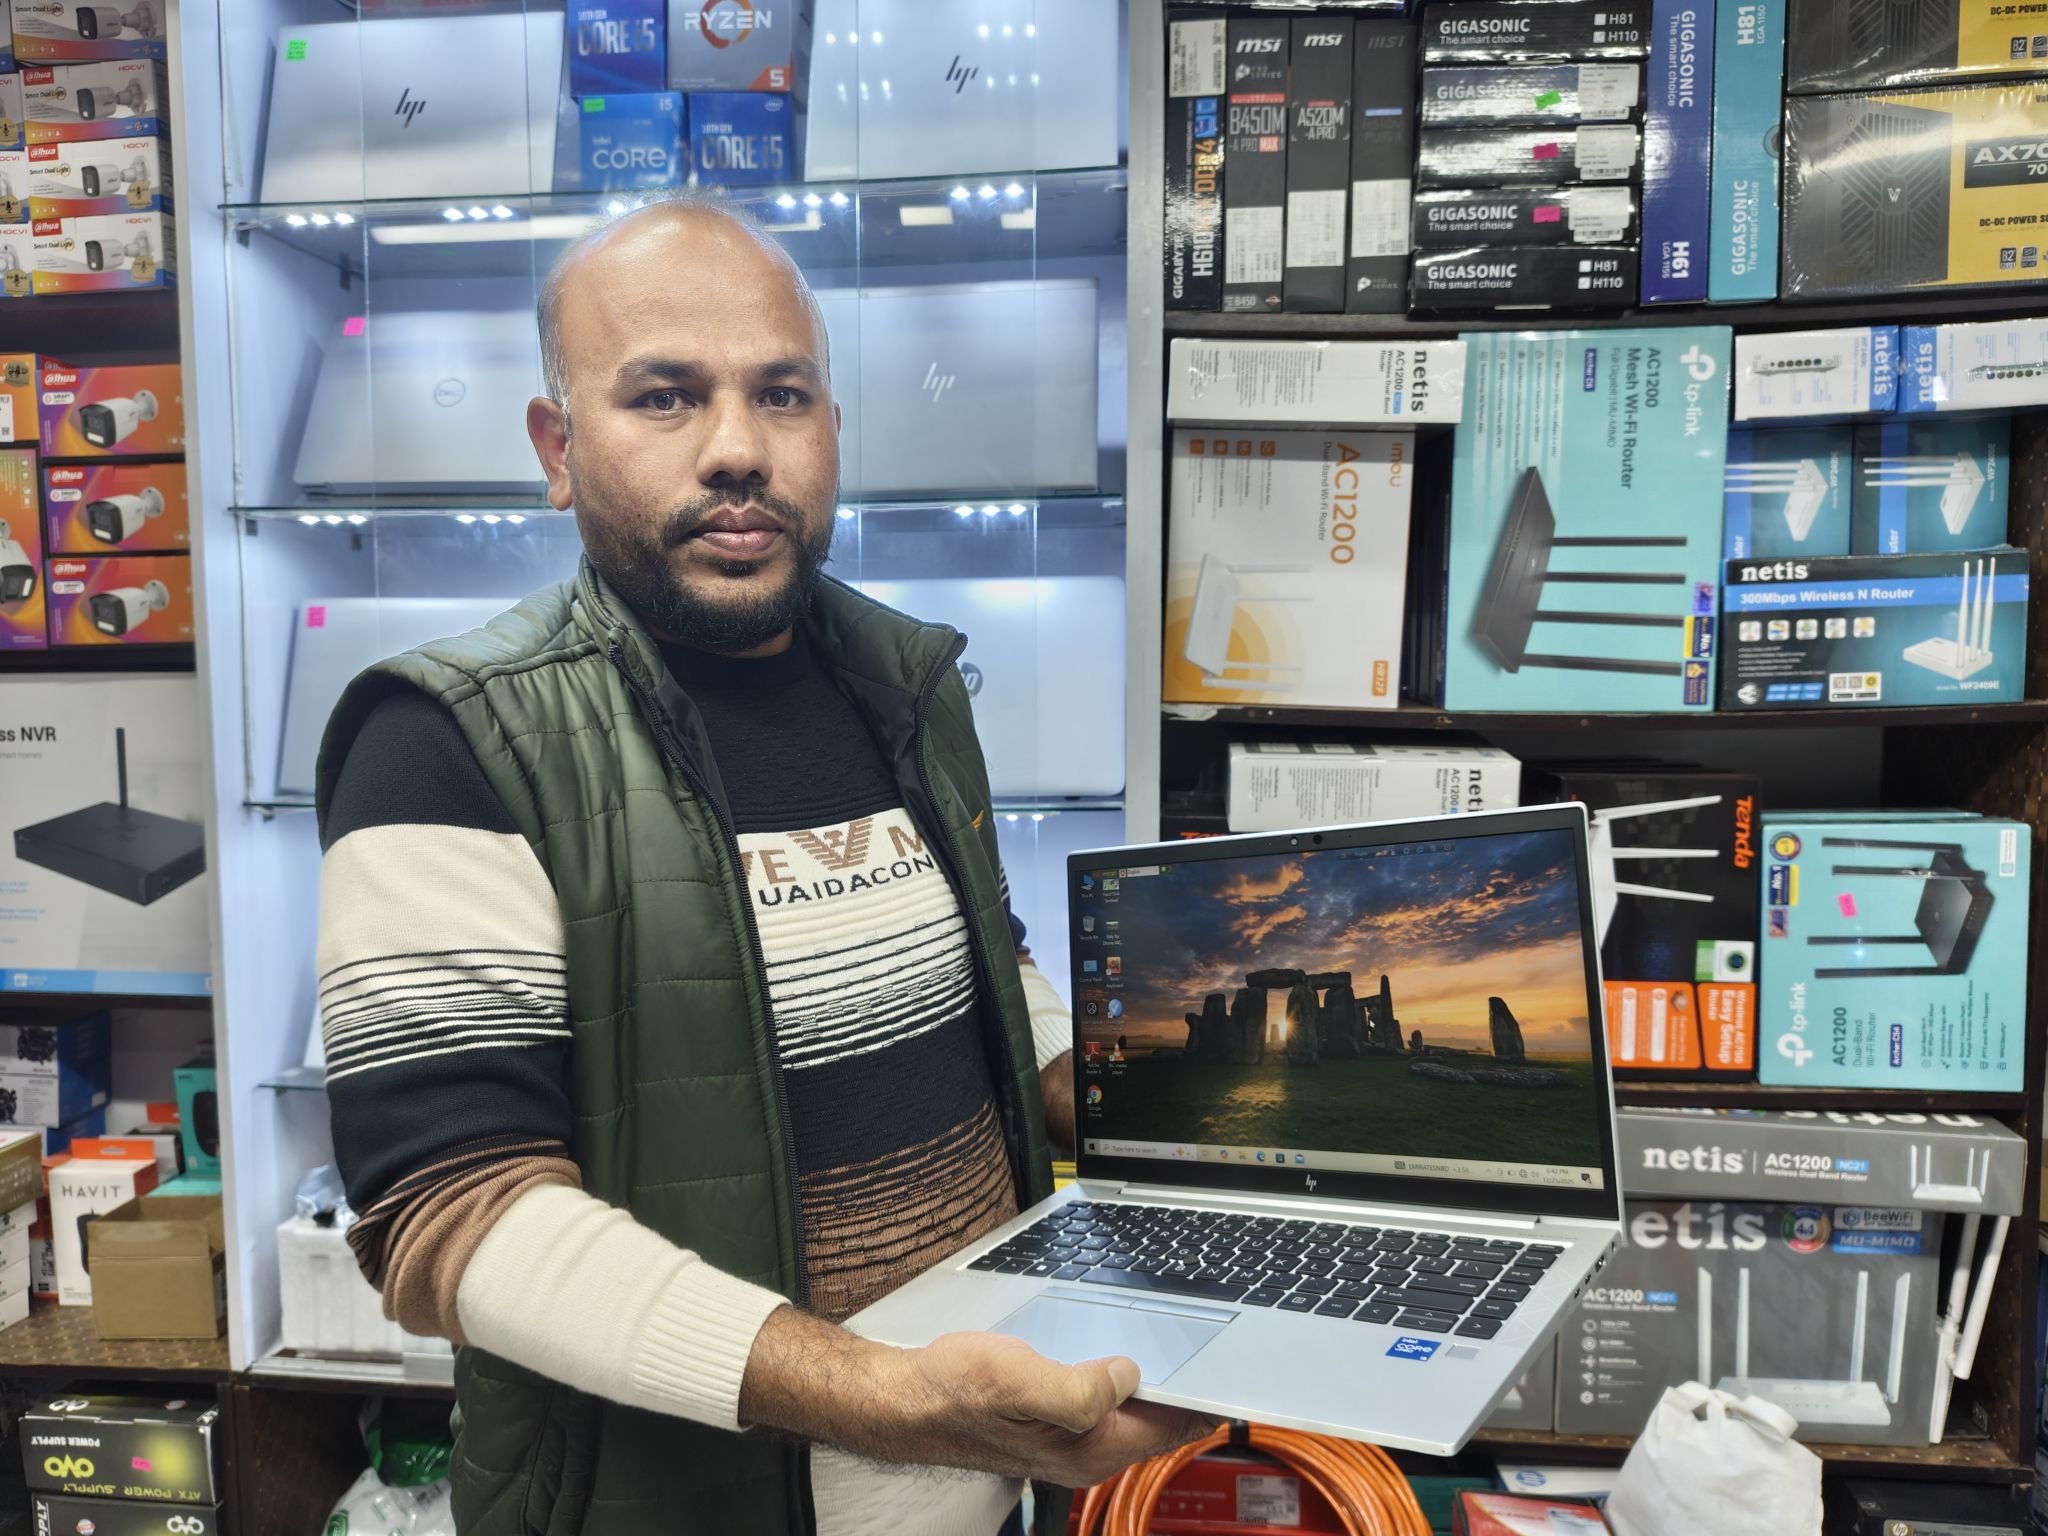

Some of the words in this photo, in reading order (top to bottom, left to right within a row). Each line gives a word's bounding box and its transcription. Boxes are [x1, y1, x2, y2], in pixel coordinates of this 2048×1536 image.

[33, 4, 47, 12] Dual
[1990, 6, 2016, 16] DC-DC
[2018, 3, 2048, 14] POWER
[684, 10, 772, 31] RYZEN
[1439, 19, 1531, 34] GIGASONIC
[1609, 14, 1633, 25] H81
[1669, 14, 1680, 35] The
[1737, 5, 1755, 45] H81
[577, 20, 630, 56] CORE
[634, 18, 655, 50] i5
[1235, 37, 1282, 53] msi
[1304, 34, 1344, 47] msi
[1368, 35, 1405, 49] msi
[1440, 36, 1458, 44] The
[1461, 36, 1493, 44] smart
[1495, 34, 1526, 44] choice
[1608, 31, 1639, 42] H110
[2013, 39, 2025, 51] 82
[1669, 38, 1679, 68] smart
[1679, 10, 1696, 108] GIGASONIC
[769, 69, 785, 87] 5
[945, 54, 979, 94] hp
[40, 90, 51, 99] Dual
[1668, 70, 1678, 107] choice
[395, 87, 426, 128] hp
[659, 98, 673, 111] i5
[1229, 106, 1285, 135] B450M
[1297, 106, 1344, 127] A520M
[1317, 126, 1336, 140] PRO
[702, 136, 758, 169] CORE
[761, 136, 784, 169] i5
[44, 167, 56, 175] Dual
[1428, 206, 1518, 221] GIGASONIC
[1979, 218, 2005, 227] DC-DC
[2008, 215, 2037, 225] POWER
[1428, 222, 1446, 231] The
[1449, 222, 1480, 231] smart
[1482, 221, 1513, 230] choice
[1731, 179, 1748, 275] GIGASONIC
[1748, 218, 1759, 249] smart
[48, 241, 60, 250] Dual
[1173, 233, 1184, 299] GIGABYTE
[1594, 260, 1618, 272] H81
[1672, 241, 1690, 279] H61
[1747, 252, 1758, 271] The
[2002, 251, 2014, 262] 82
[1428, 264, 1518, 279] GIGASONIC
[1428, 281, 1446, 289] The
[1449, 280, 1479, 289] smart
[1481, 279, 1512, 289] choice
[1592, 277, 1623, 289] H110
[1393, 350, 1405, 390] AC1200
[1625, 348, 1641, 391] Mesh
[1874, 334, 1890, 396] netis
[1918, 342, 1933, 403] netis
[923, 362, 955, 403] hp
[1411, 350, 1429, 412] netis
[1645, 347, 1661, 408] AC1200
[1623, 393, 1638, 434] Wi-Fi
[1684, 388, 1701, 437] tp-link
[1320, 441, 1332, 487] Dual-Band
[1620, 438, 1635, 490] Router
[1319, 489, 1329, 510] Wi-Fi
[1330, 442, 1361, 565] AC1200
[1317, 512, 1327, 541] Router
[1741, 561, 1808, 582] netis
[1740, 592, 1796, 605] 300Mbps
[1800, 590, 1853, 603] Wireless
[1857, 589, 1868, 600] N
[1871, 587, 1915, 600] Router
[21, 727, 57, 742] NVR
[1450, 768, 1460, 806] AC1200
[1734, 795, 1754, 869] Tenda
[1719, 990, 1735, 1022] Easy
[1790, 982, 1807, 1031] tp-link
[1717, 1024, 1734, 1063] Setup
[1832, 1006, 1847, 1067] AC1200
[1642, 1145, 1744, 1173] netis
[1764, 1153, 1831, 1171] AC1200
[62, 1184, 120, 1198] HAVIT
[1630, 1202, 1767, 1251] etis
[1863, 1210, 1914, 1222] BeeWiFi
[1583, 1288, 1644, 1303] AC1200
[31, 1436, 66, 1446] SUPPLY
[69, 1437, 101, 1447] POWER
[63, 1483, 116, 1495] SUPPLY
[124, 1486, 173, 1498] POWER
